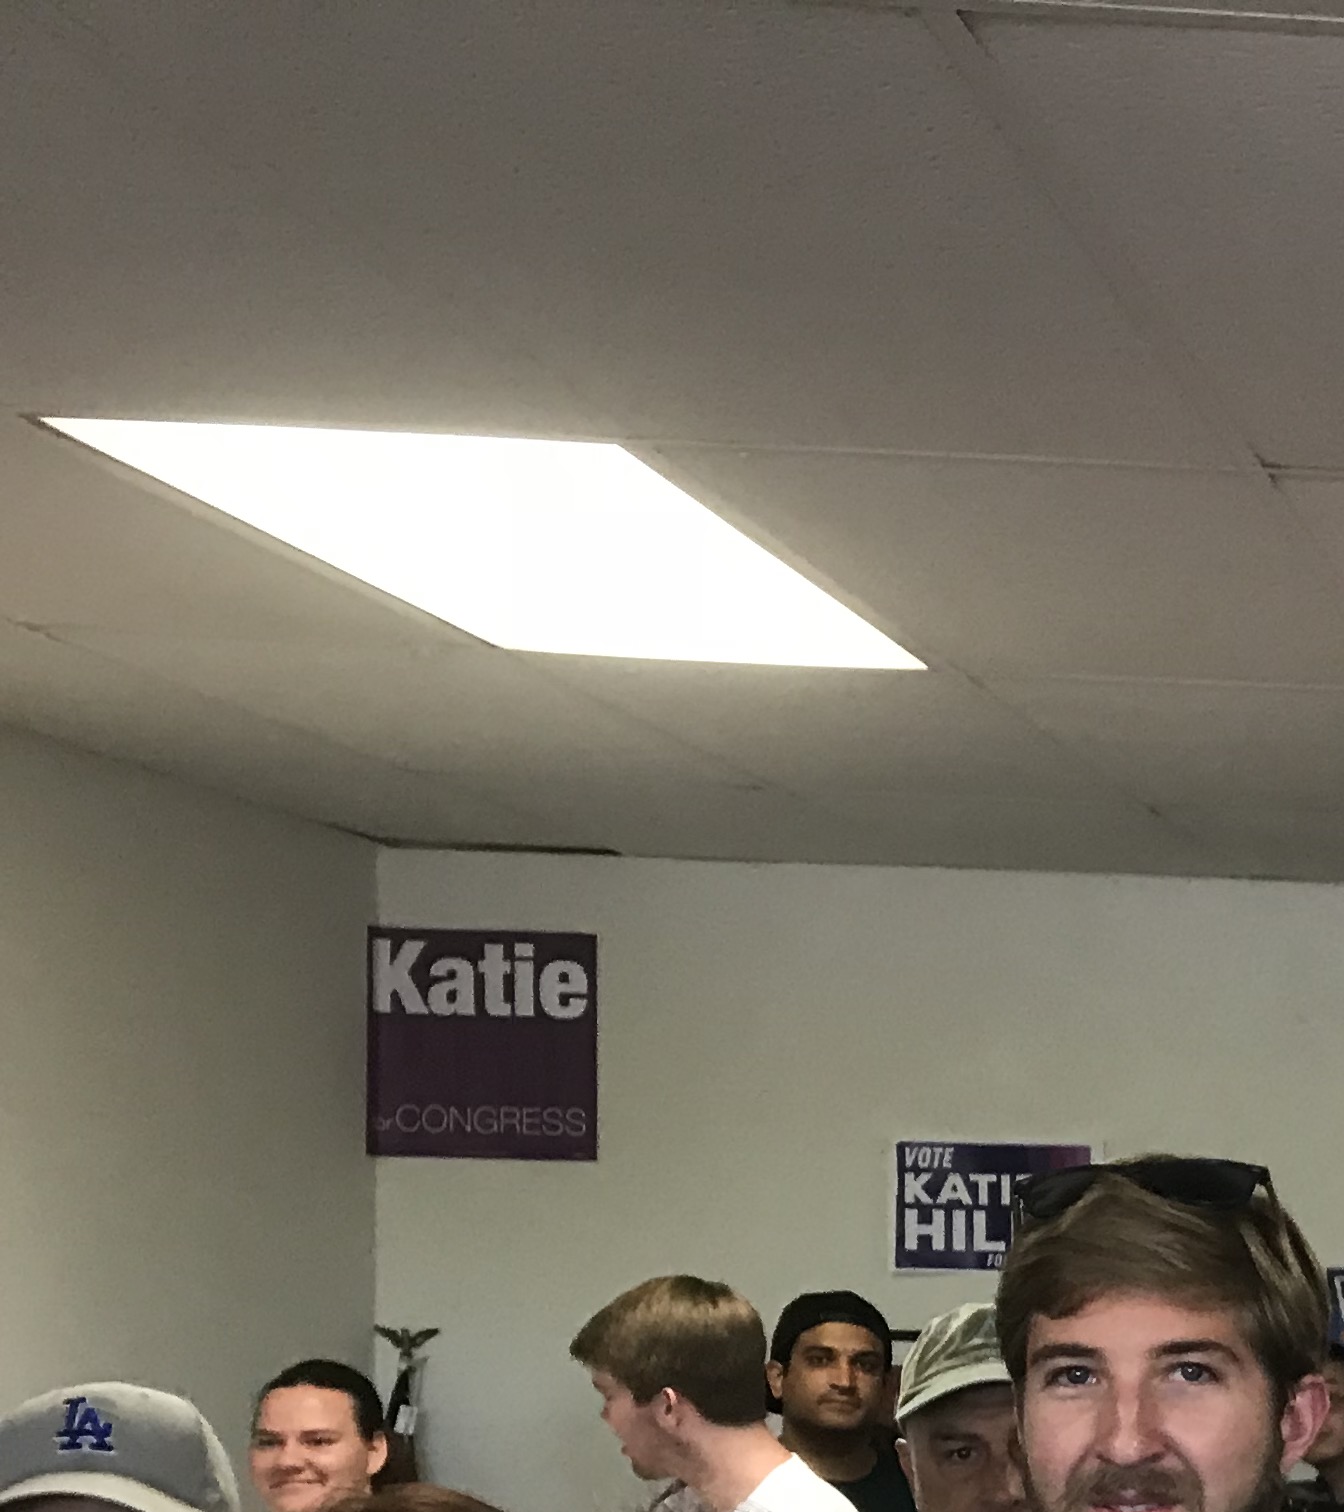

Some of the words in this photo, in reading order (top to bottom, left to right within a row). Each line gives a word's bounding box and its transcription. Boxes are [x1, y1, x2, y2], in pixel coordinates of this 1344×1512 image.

[372, 937, 589, 1019] Katie
[395, 1103, 587, 1137] CONGRESS
[904, 1146, 955, 1169] VOTE
[904, 1172, 1033, 1206] KATI
[904, 1207, 1014, 1252] HIL
[56, 1396, 115, 1452] LA
